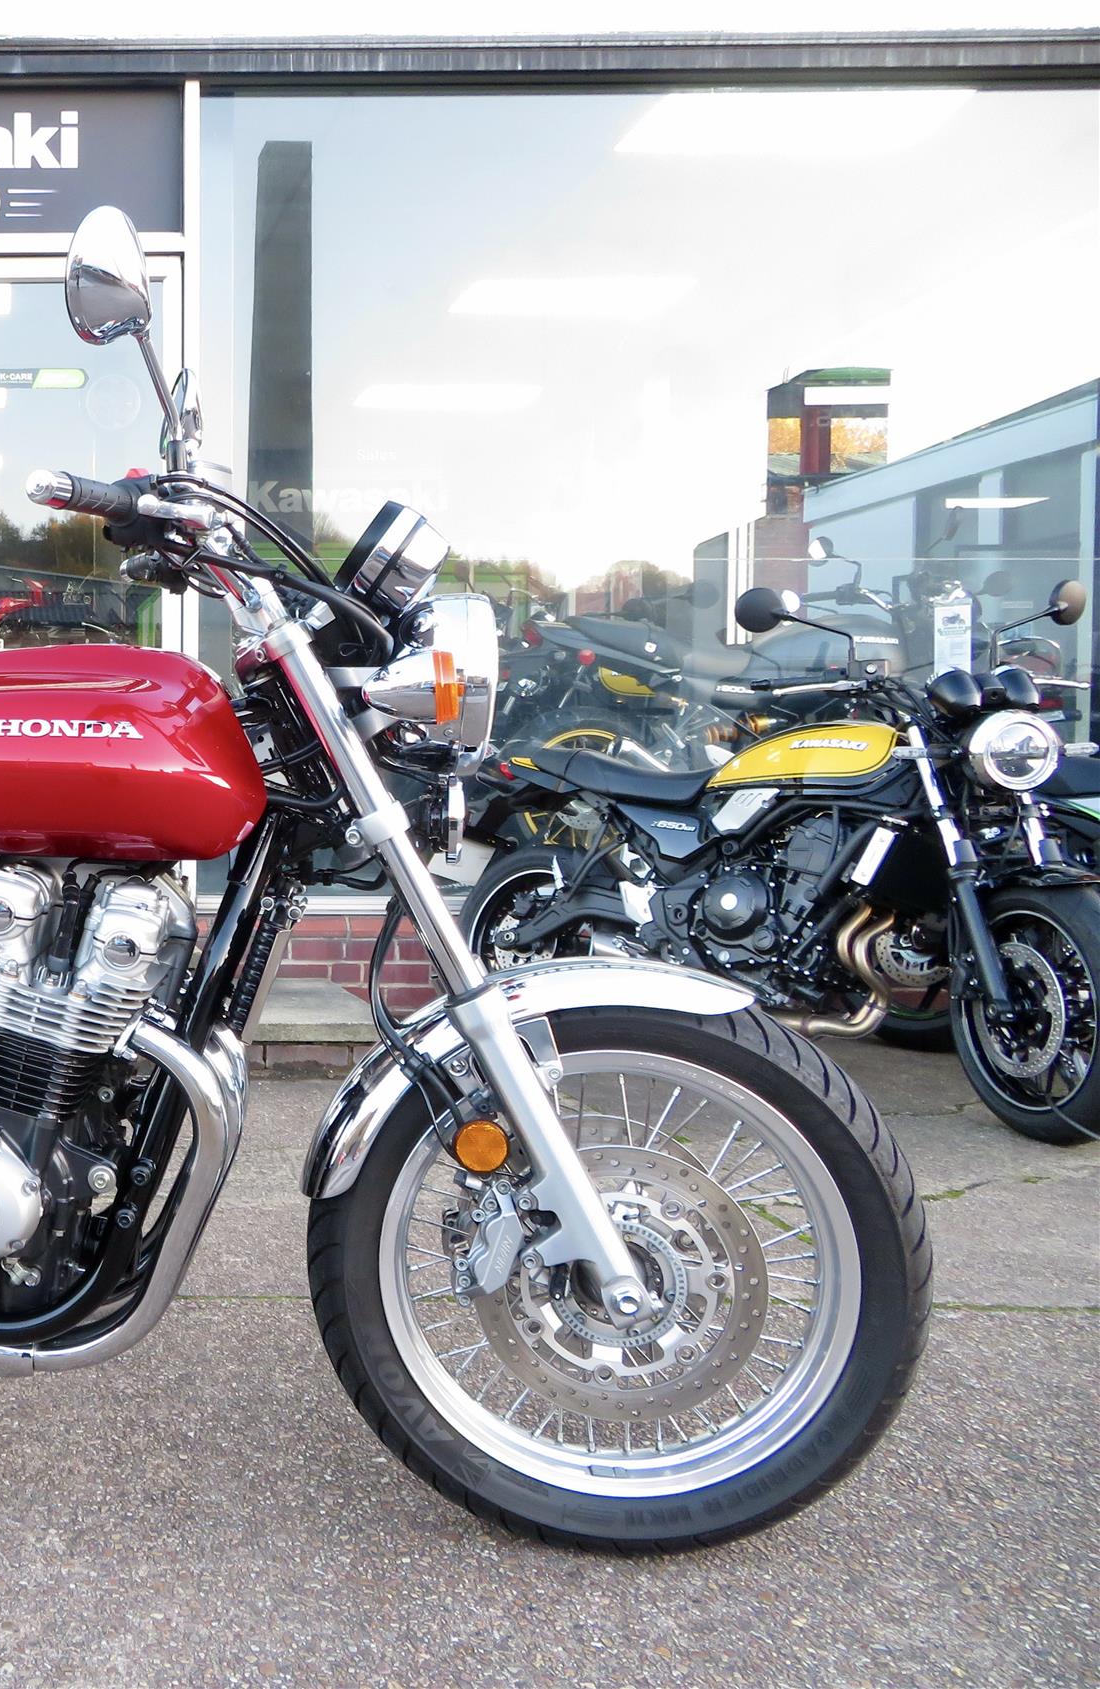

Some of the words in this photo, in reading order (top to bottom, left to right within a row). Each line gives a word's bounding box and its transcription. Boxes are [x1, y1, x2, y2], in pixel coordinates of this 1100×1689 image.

[249, 481, 449, 513] Kawasaki
[791, 739, 868, 751] KAWASAKI
[356, 1322, 453, 1441] AVON
